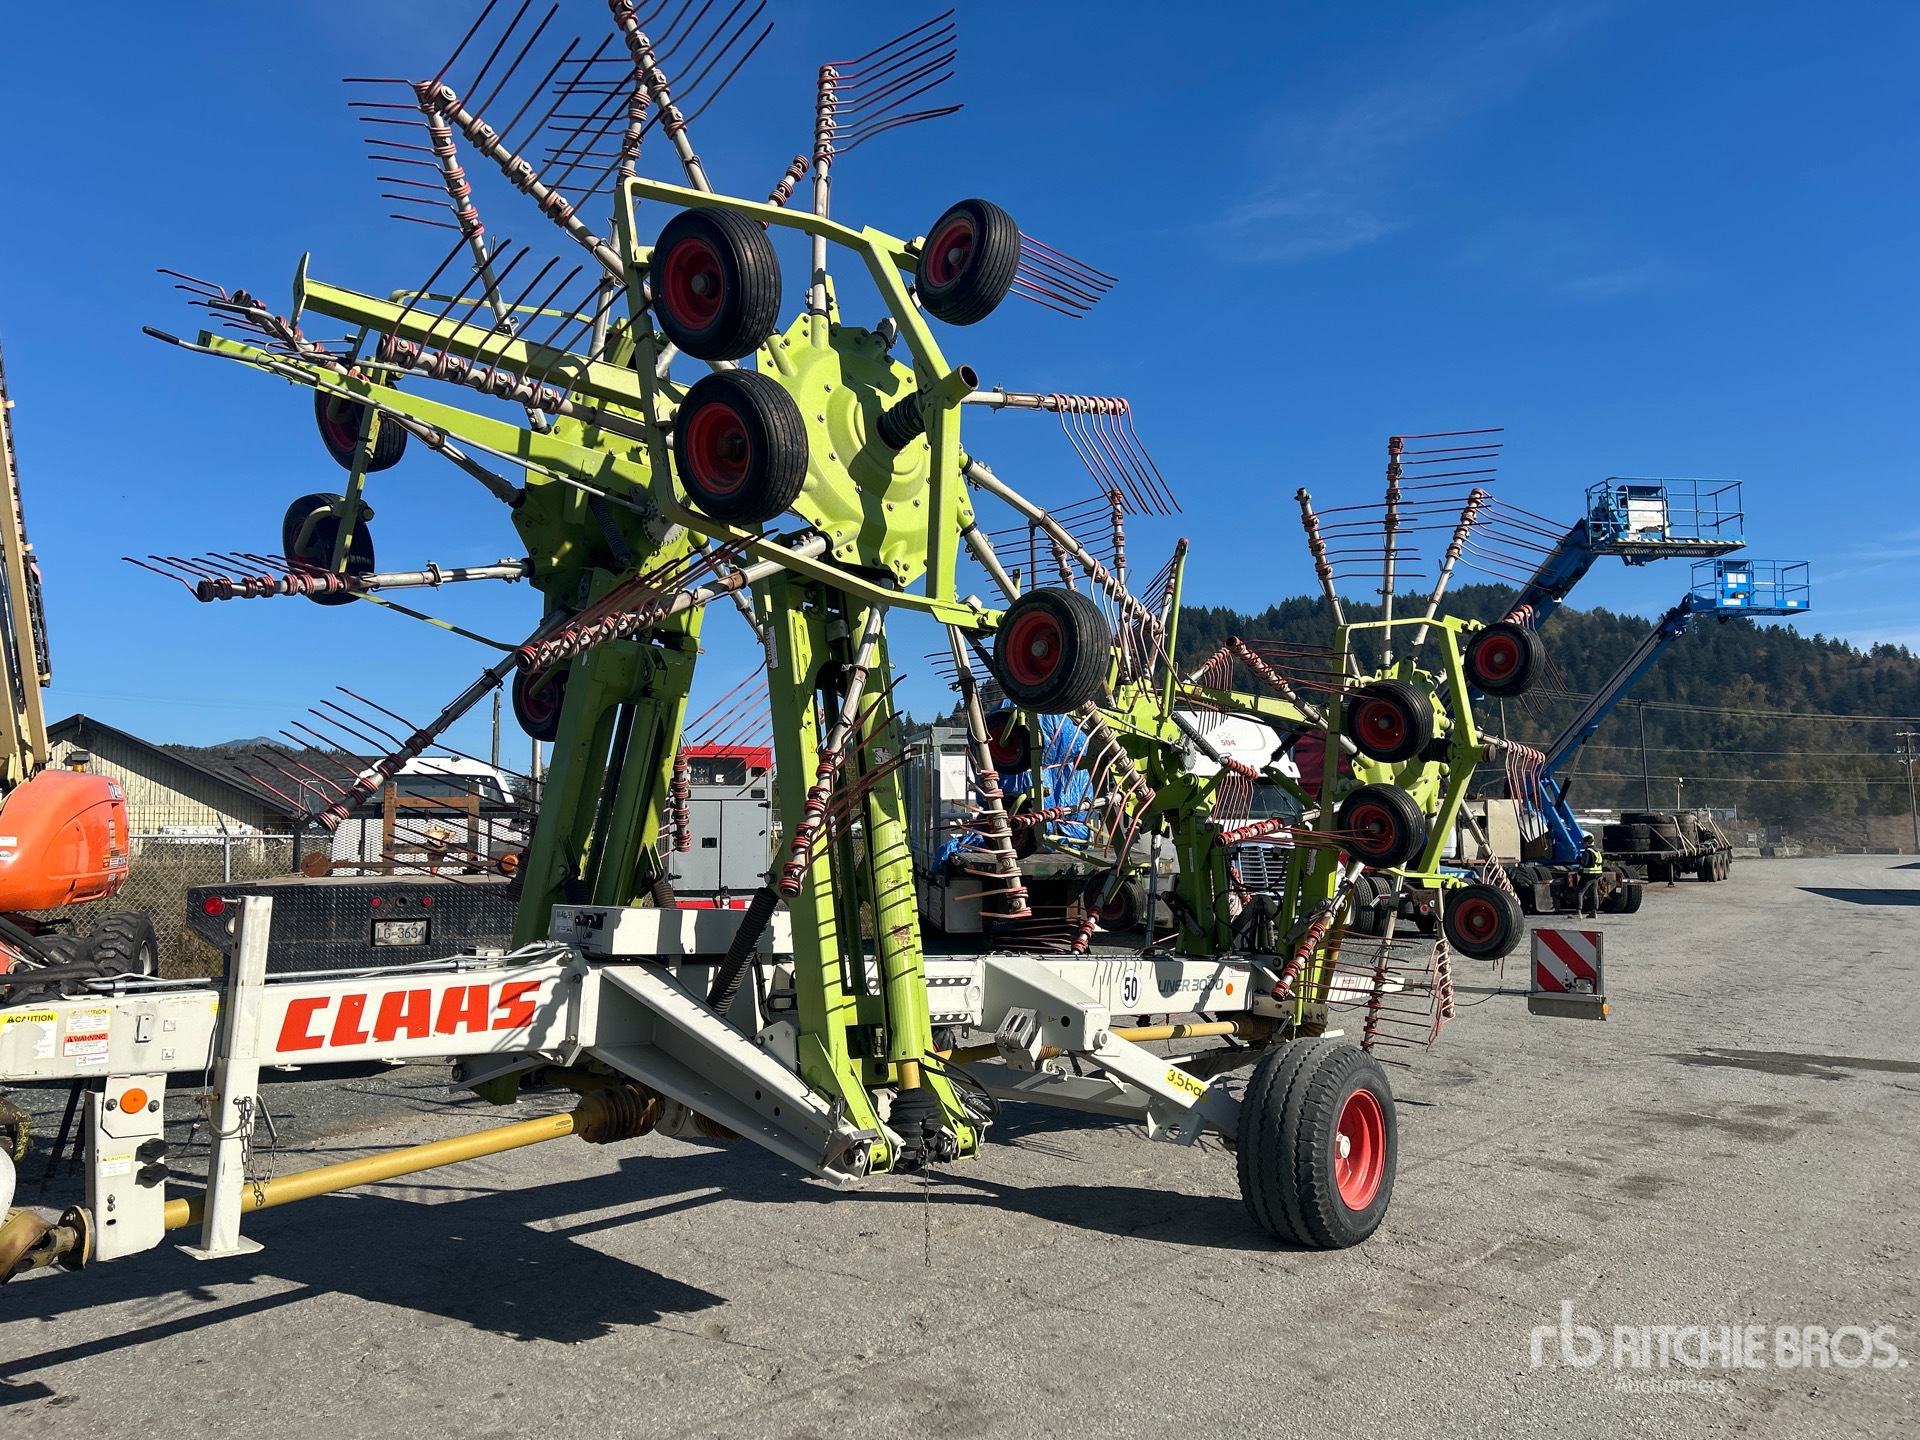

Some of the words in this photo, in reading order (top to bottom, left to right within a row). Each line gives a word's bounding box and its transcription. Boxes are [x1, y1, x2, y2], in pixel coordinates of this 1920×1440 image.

[1124, 977, 1138, 1001] 50
[1159, 979, 1190, 992] LINER
[1192, 979, 1224, 991] 3000
[15, 1014, 54, 1023] CAUTION
[276, 980, 542, 1052] CLAAS
[73, 1033, 106, 1042] WARNING
